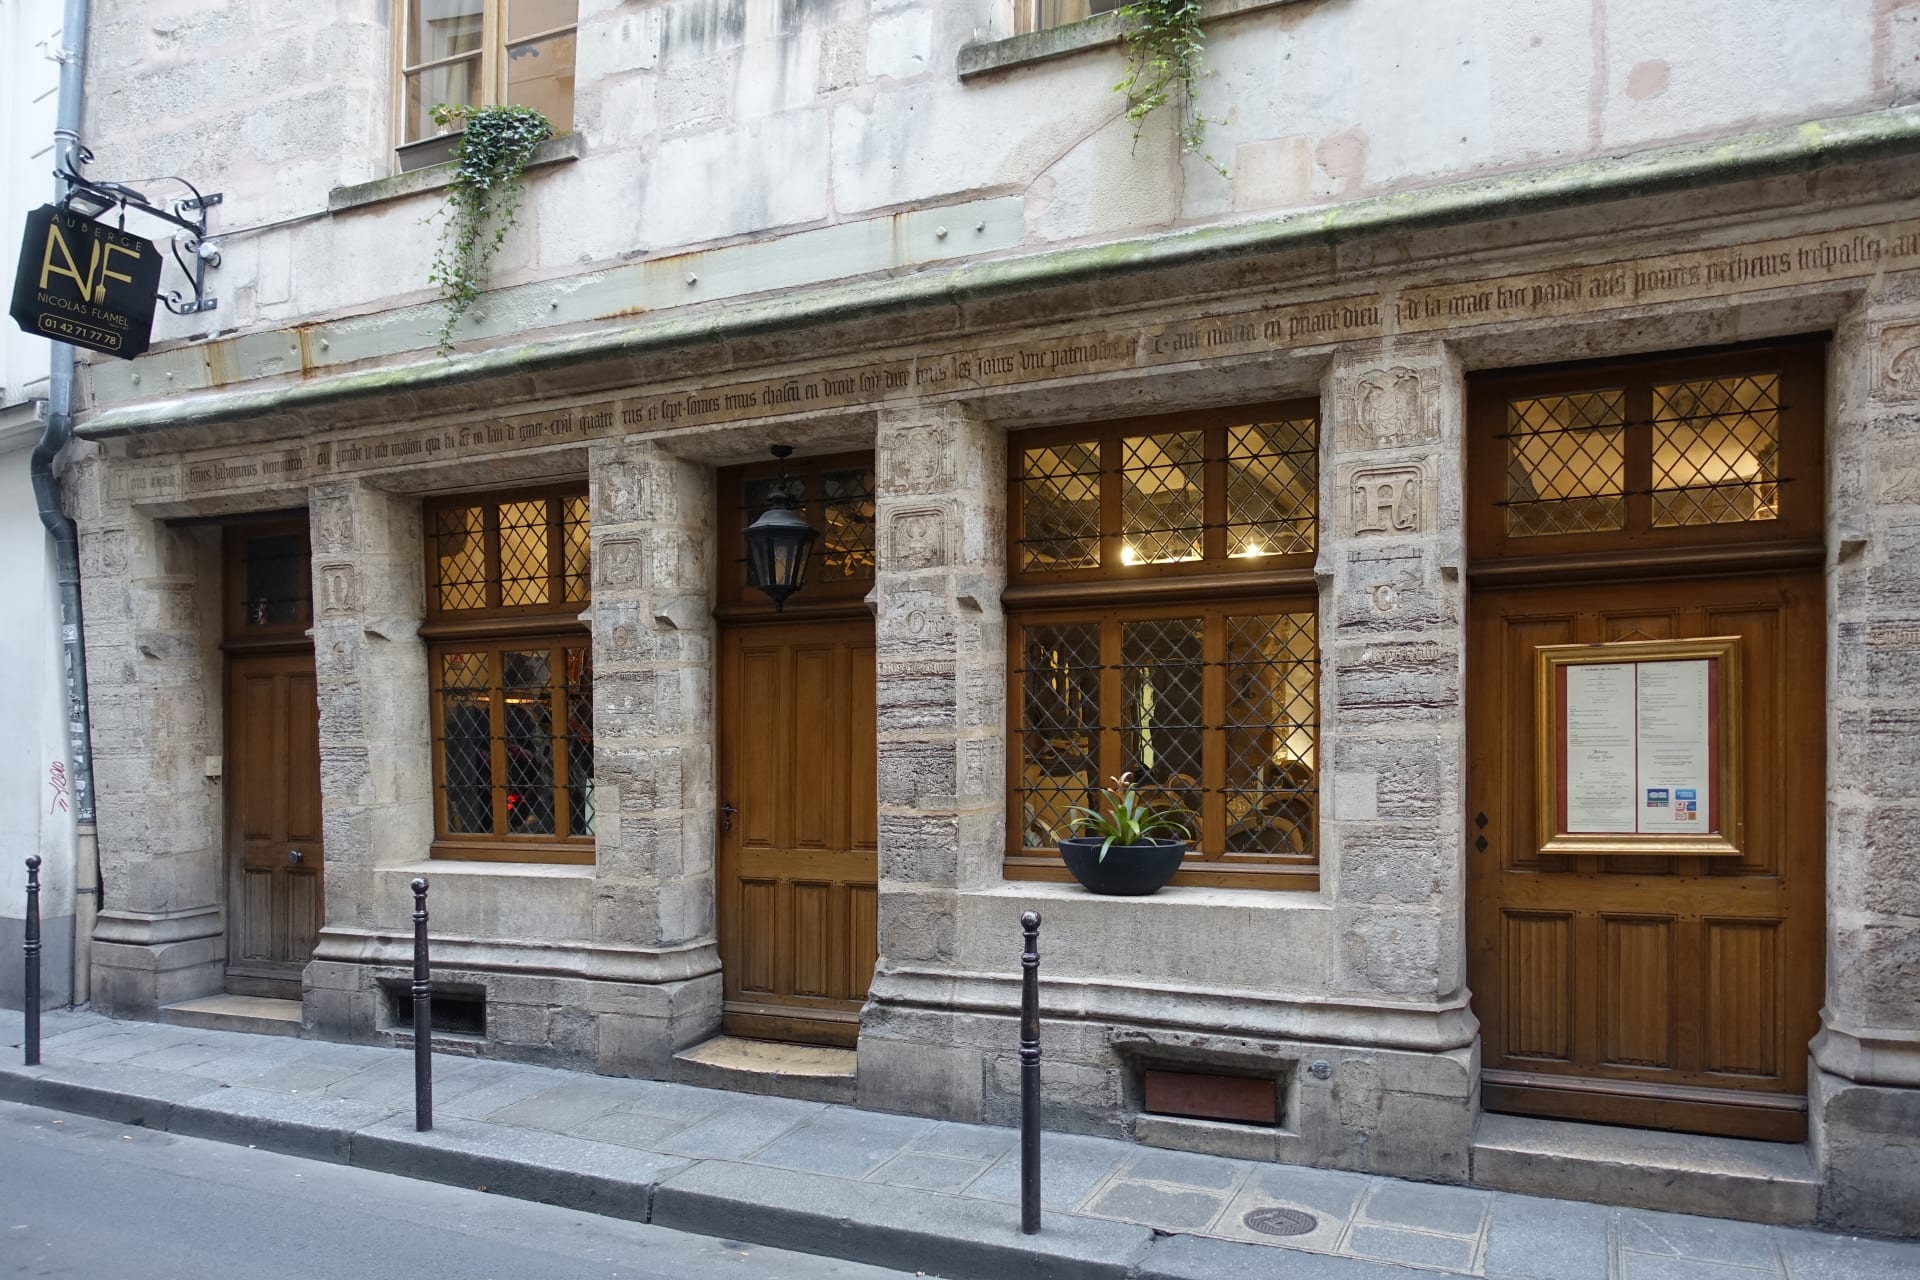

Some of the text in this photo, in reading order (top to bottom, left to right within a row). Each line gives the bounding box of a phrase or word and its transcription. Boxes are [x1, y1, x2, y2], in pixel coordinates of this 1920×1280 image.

[51, 213, 142, 252] AUBERGE
[37, 292, 87, 315] NICOLAS
[91, 307, 129, 327] FLAMEL
[44, 318, 117, 345] 01 42 71 77 78
[805, 384, 818, 398] en
[822, 375, 854, 395] droit
[1342, 303, 1379, 325] dieu
